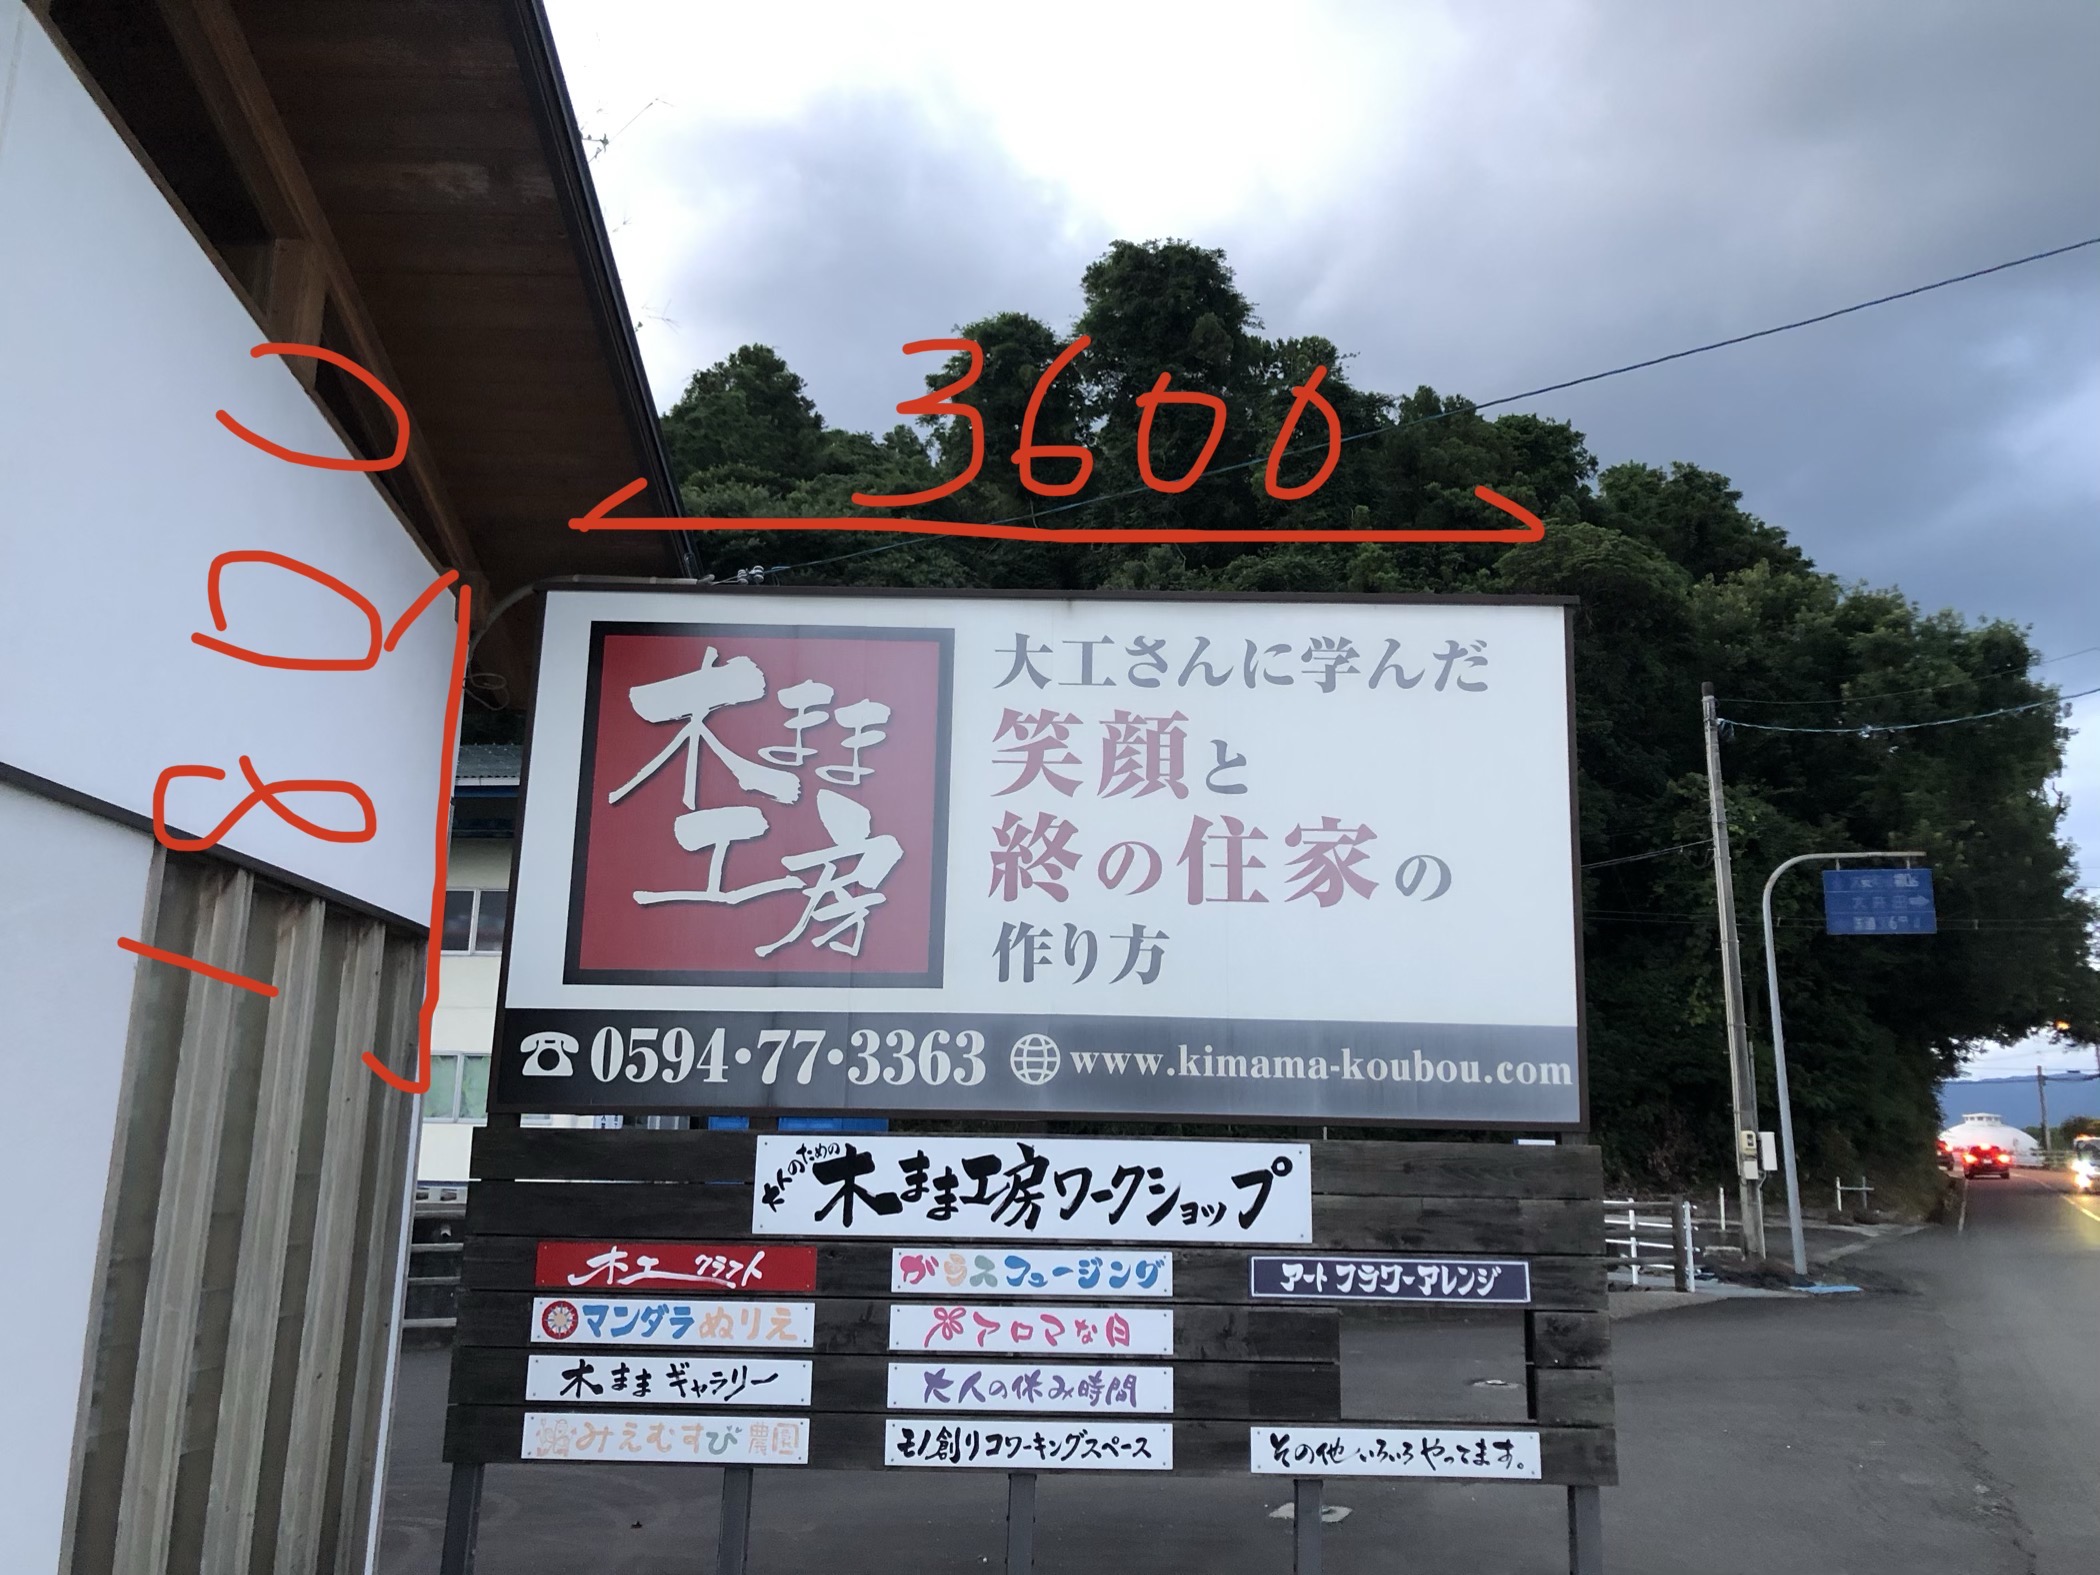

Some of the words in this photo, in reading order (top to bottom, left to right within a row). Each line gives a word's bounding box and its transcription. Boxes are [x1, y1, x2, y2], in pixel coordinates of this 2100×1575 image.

[992, 632, 1489, 694] 大工さんに学んだ
[608, 645, 893, 810] 木まま
[990, 707, 1249, 800] 笑顔と
[632, 788, 905, 958] 工房
[988, 810, 1453, 908] 終の住家の
[991, 921, 1170, 985] 作り方
[1069, 1044, 1573, 1086] www.kimama-koubou.com
[924, 1368, 1138, 1408] 大人の休み時間
